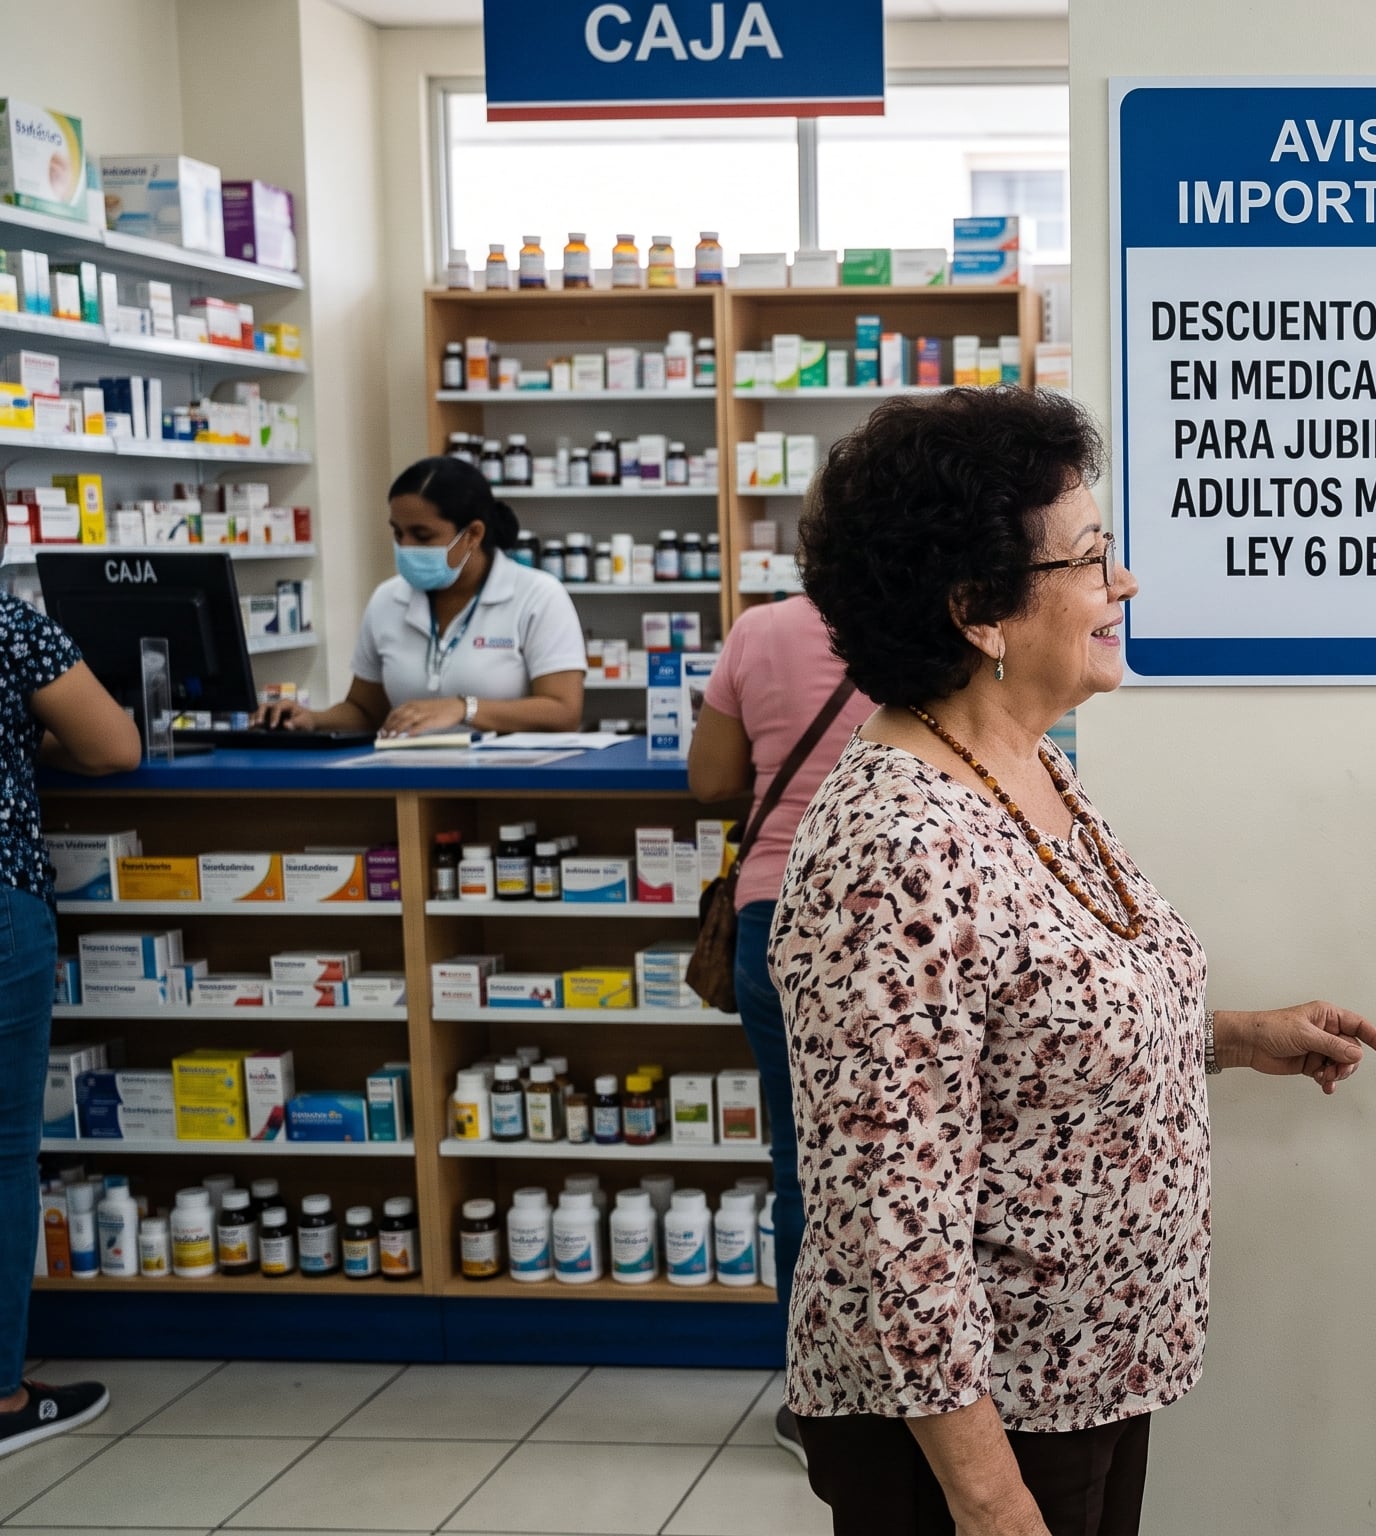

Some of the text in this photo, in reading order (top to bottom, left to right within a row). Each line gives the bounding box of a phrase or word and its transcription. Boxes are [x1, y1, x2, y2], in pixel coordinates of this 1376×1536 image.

[585, 2, 783, 62] CAJA
[1170, 360, 1217, 401] EN
[1174, 419, 1275, 459] PARA
[1170, 477, 1343, 518] ADULTOS
[104, 559, 158, 583] CAJA
[1226, 536, 1294, 577] LEY
[1304, 535, 1327, 577] 6
